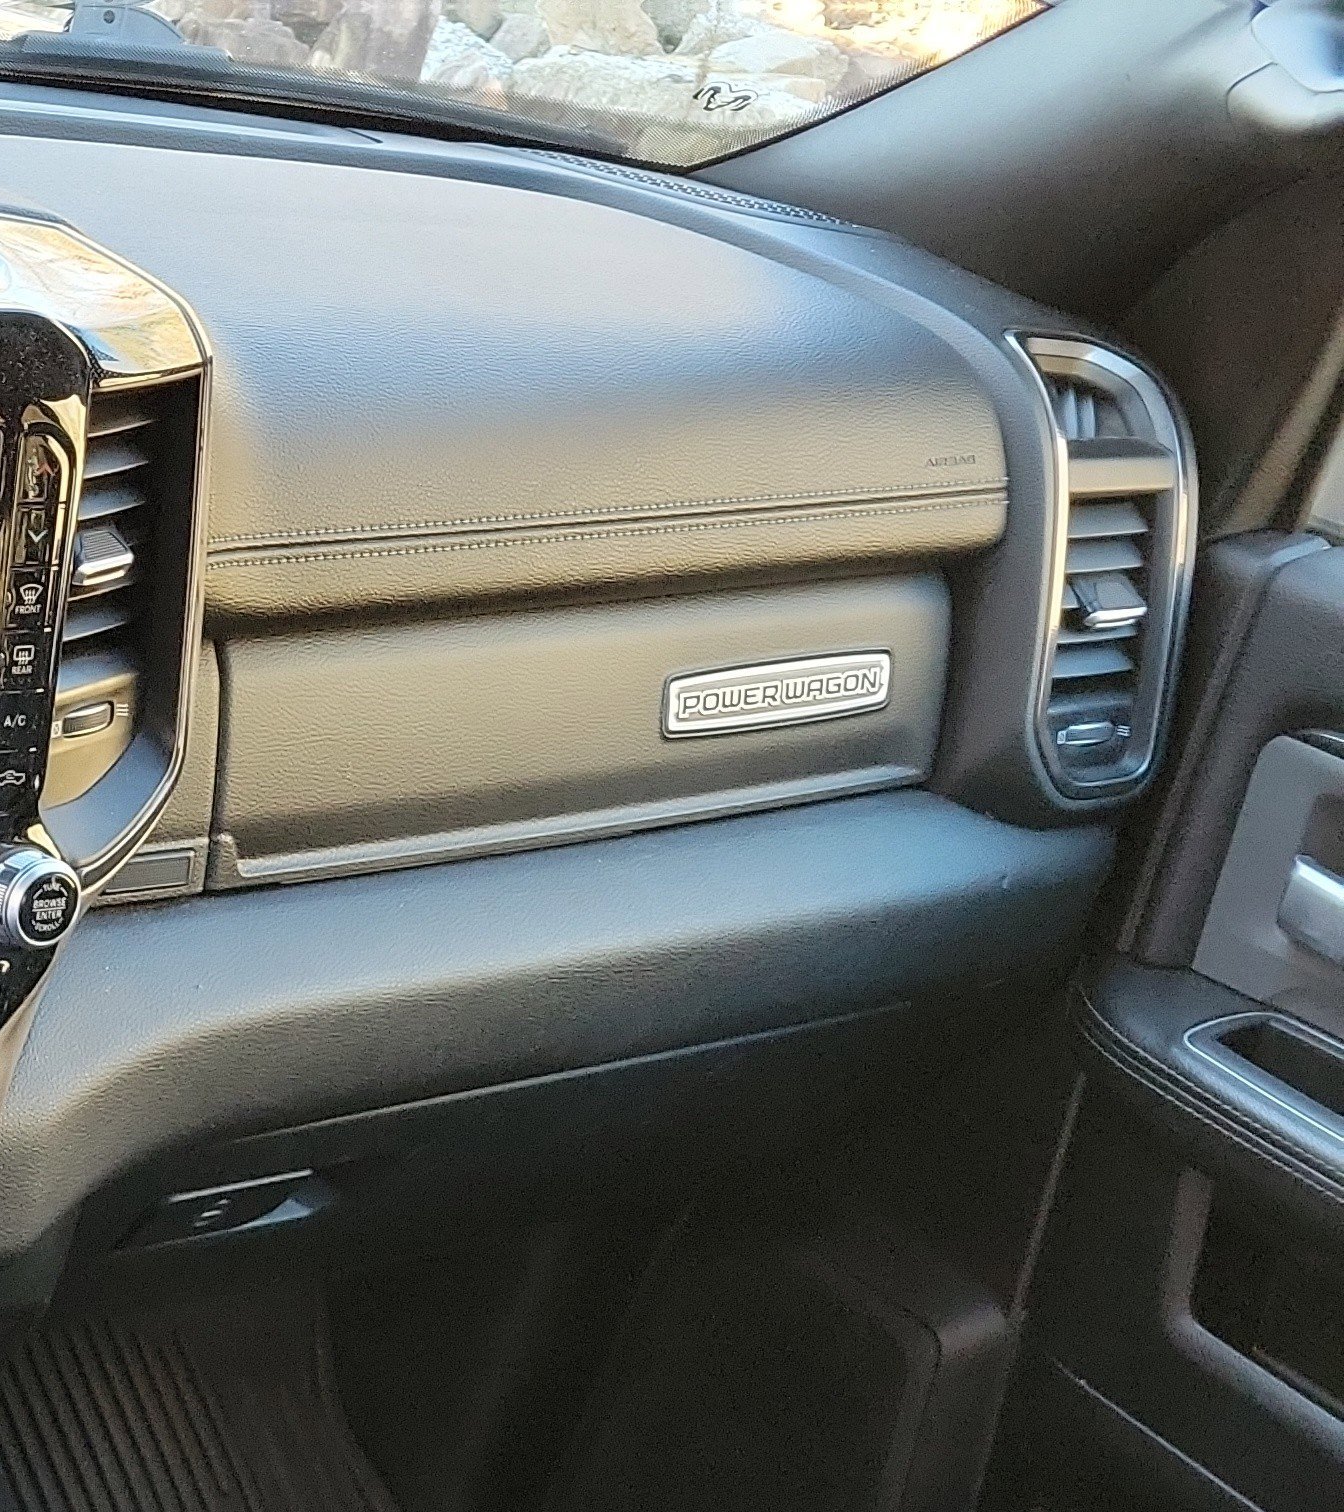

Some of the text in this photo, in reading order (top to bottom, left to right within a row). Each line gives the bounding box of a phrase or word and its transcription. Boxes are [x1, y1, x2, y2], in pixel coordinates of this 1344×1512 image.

[14, 603, 42, 615] FRONT
[677, 667, 882, 718] POWER WAGON
[3, 713, 27, 727] A/C
[35, 909, 63, 921] ENTER
